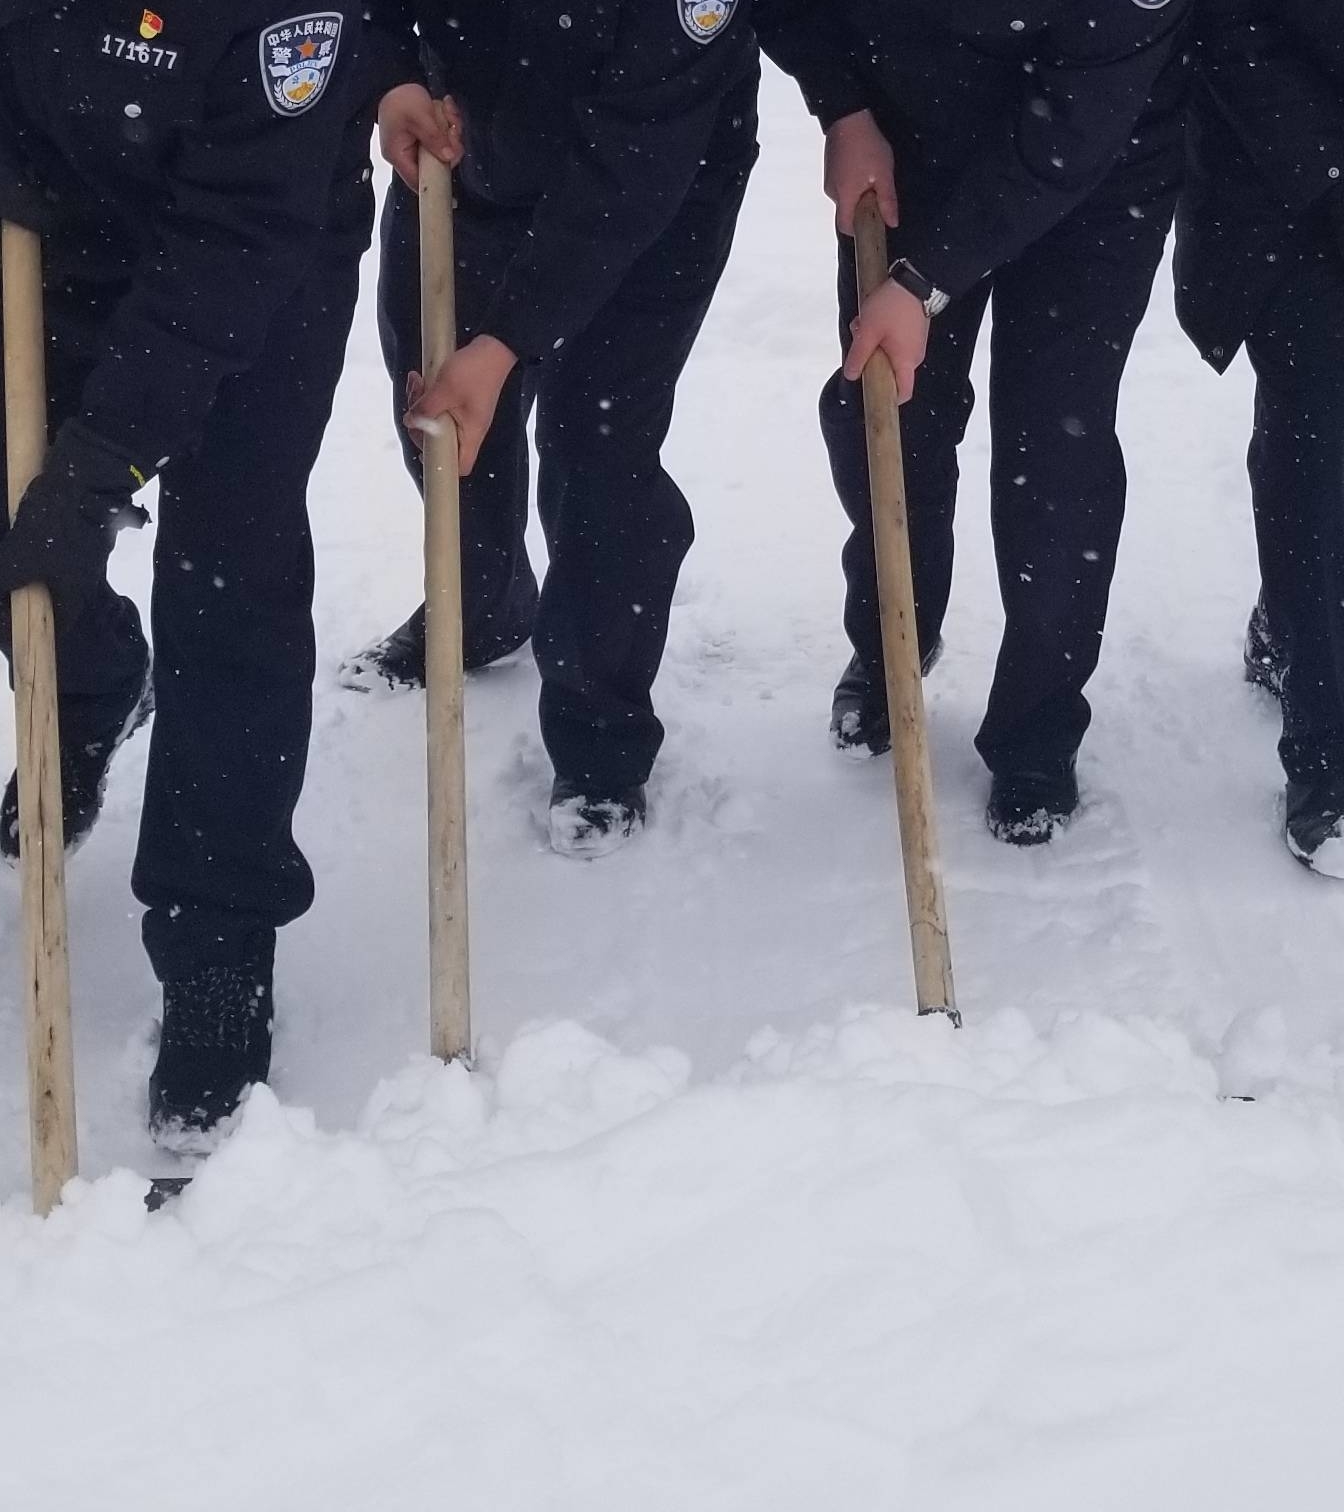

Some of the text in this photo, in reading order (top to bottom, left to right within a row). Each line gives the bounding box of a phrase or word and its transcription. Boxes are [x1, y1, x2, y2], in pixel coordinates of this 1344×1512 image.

[266, 20, 339, 47] 中华人民共和国
[100, 33, 179, 71] 171677
